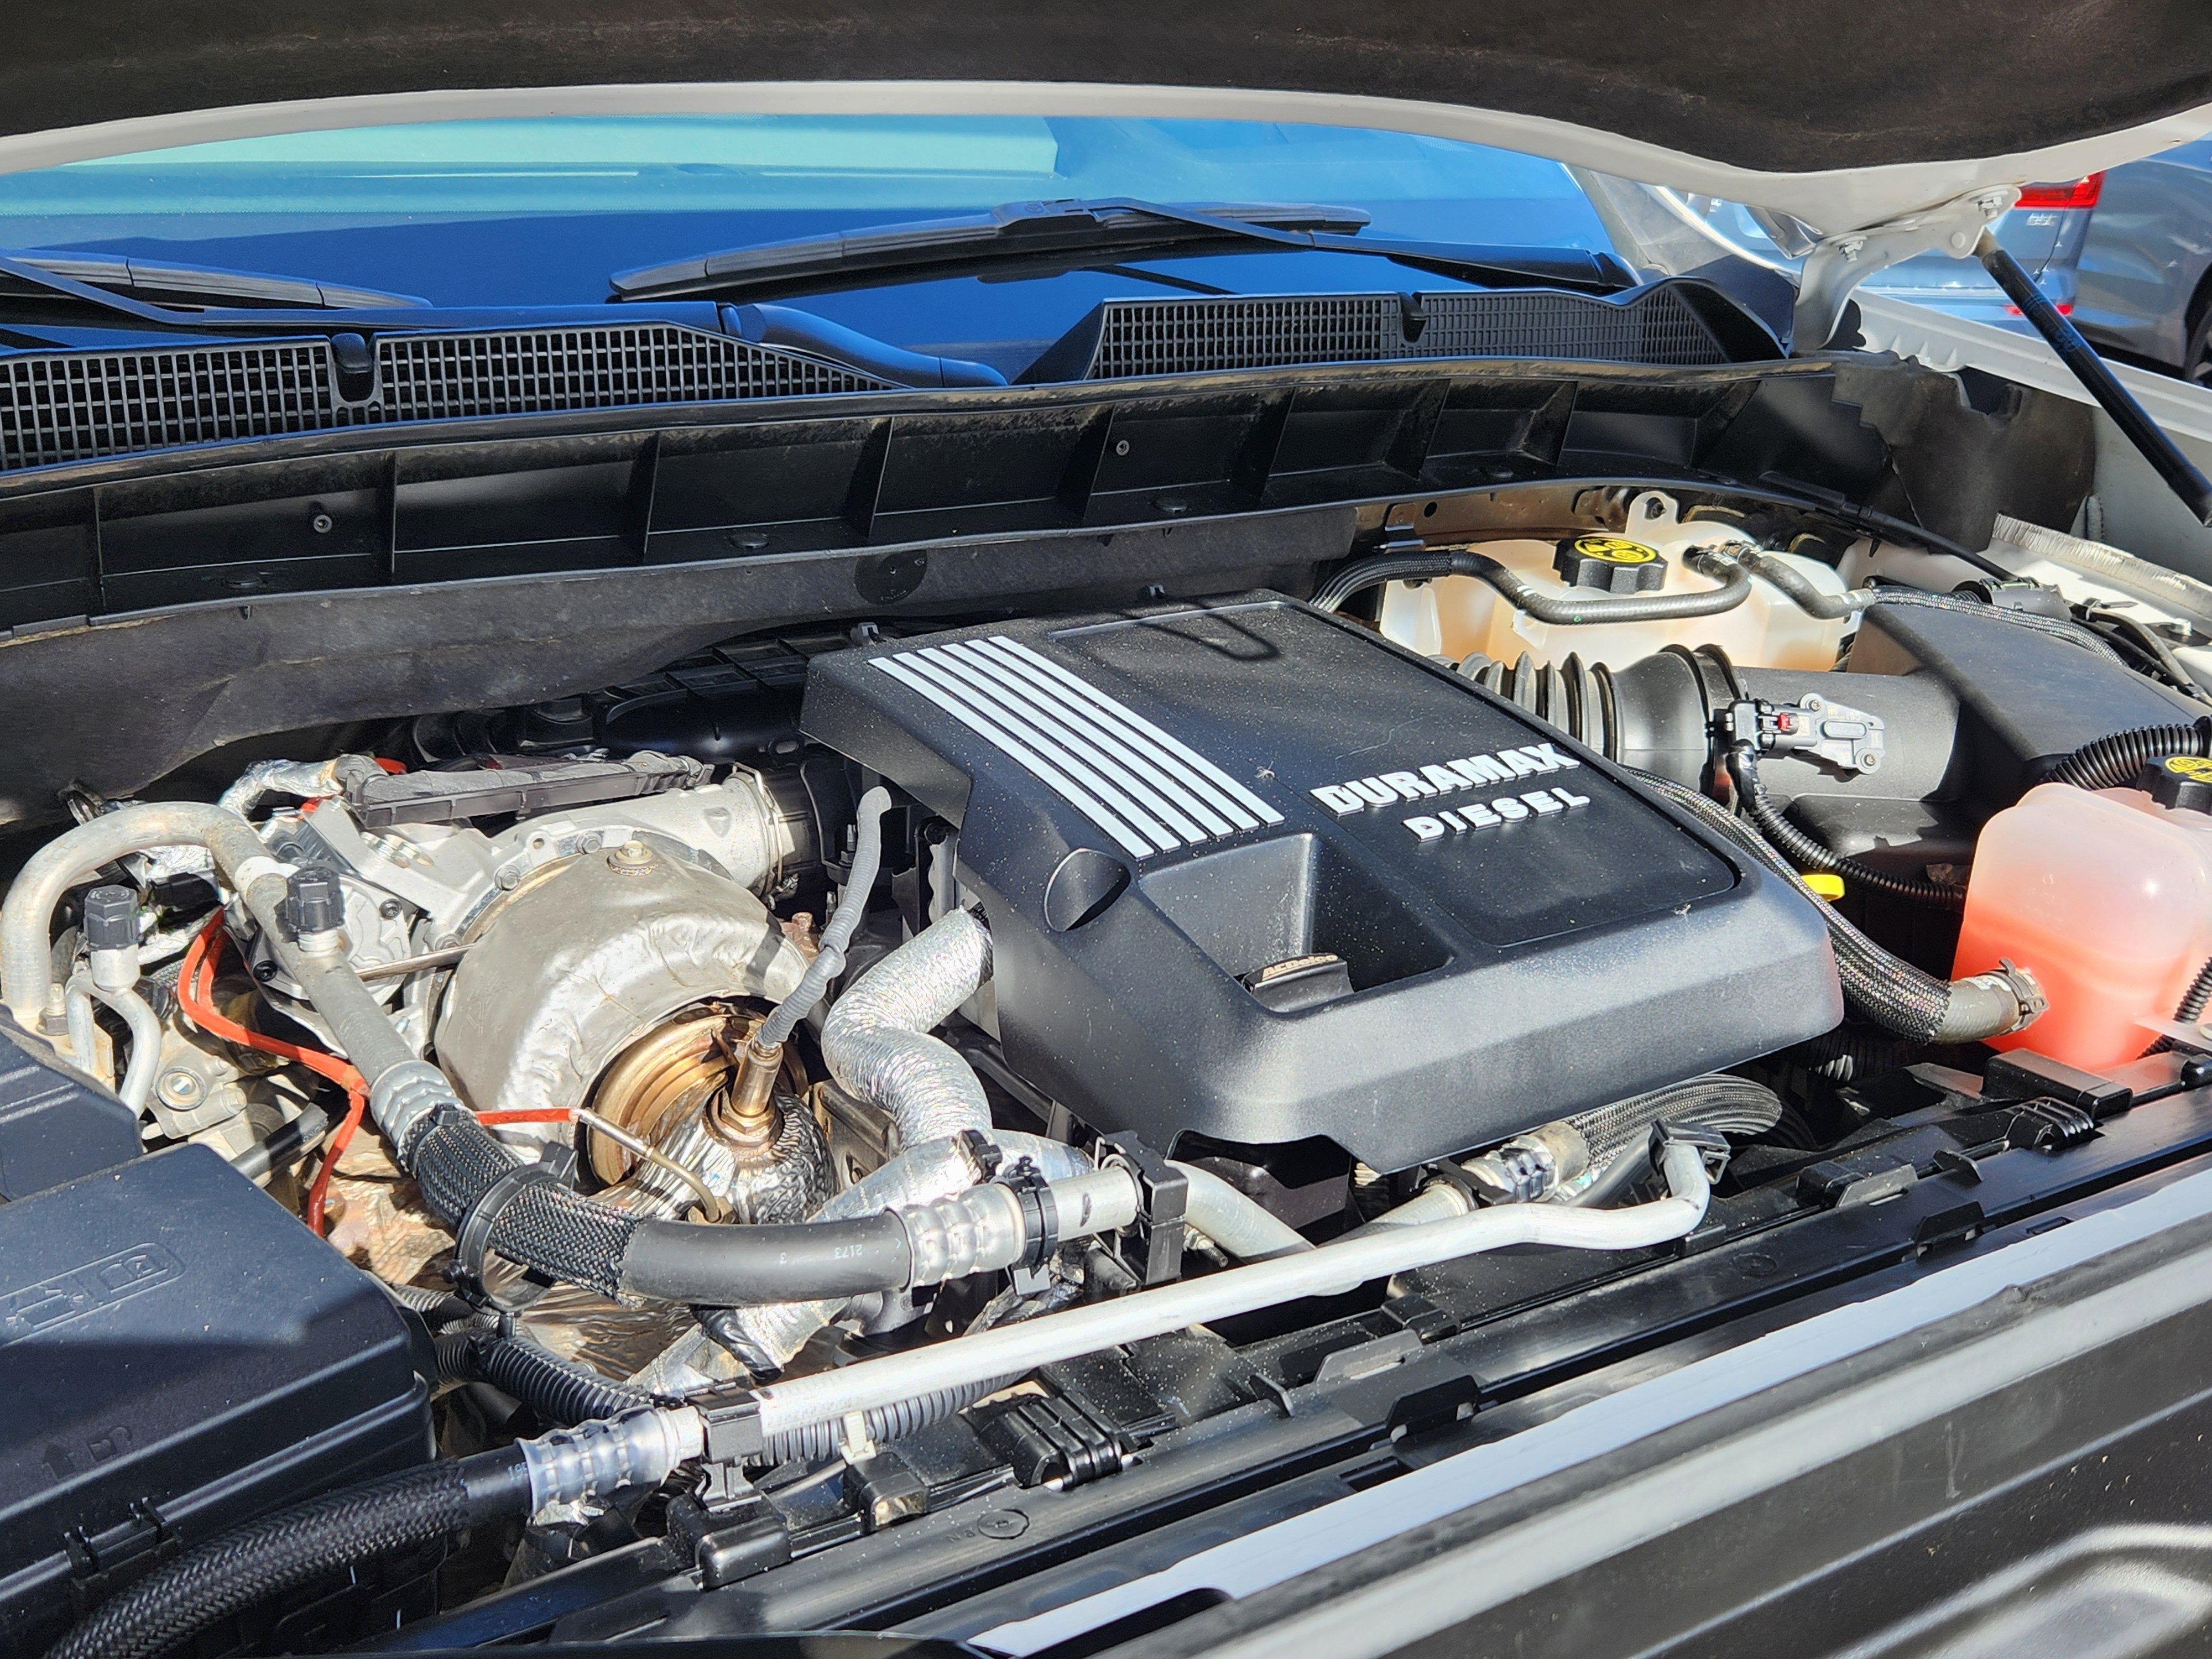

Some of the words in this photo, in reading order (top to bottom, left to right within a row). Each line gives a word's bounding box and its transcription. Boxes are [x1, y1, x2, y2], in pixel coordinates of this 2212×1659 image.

[1310, 742, 1580, 816] DURAMAX
[1401, 787, 1590, 842] DIESEL
[1262, 954, 1338, 979] ACDelco
